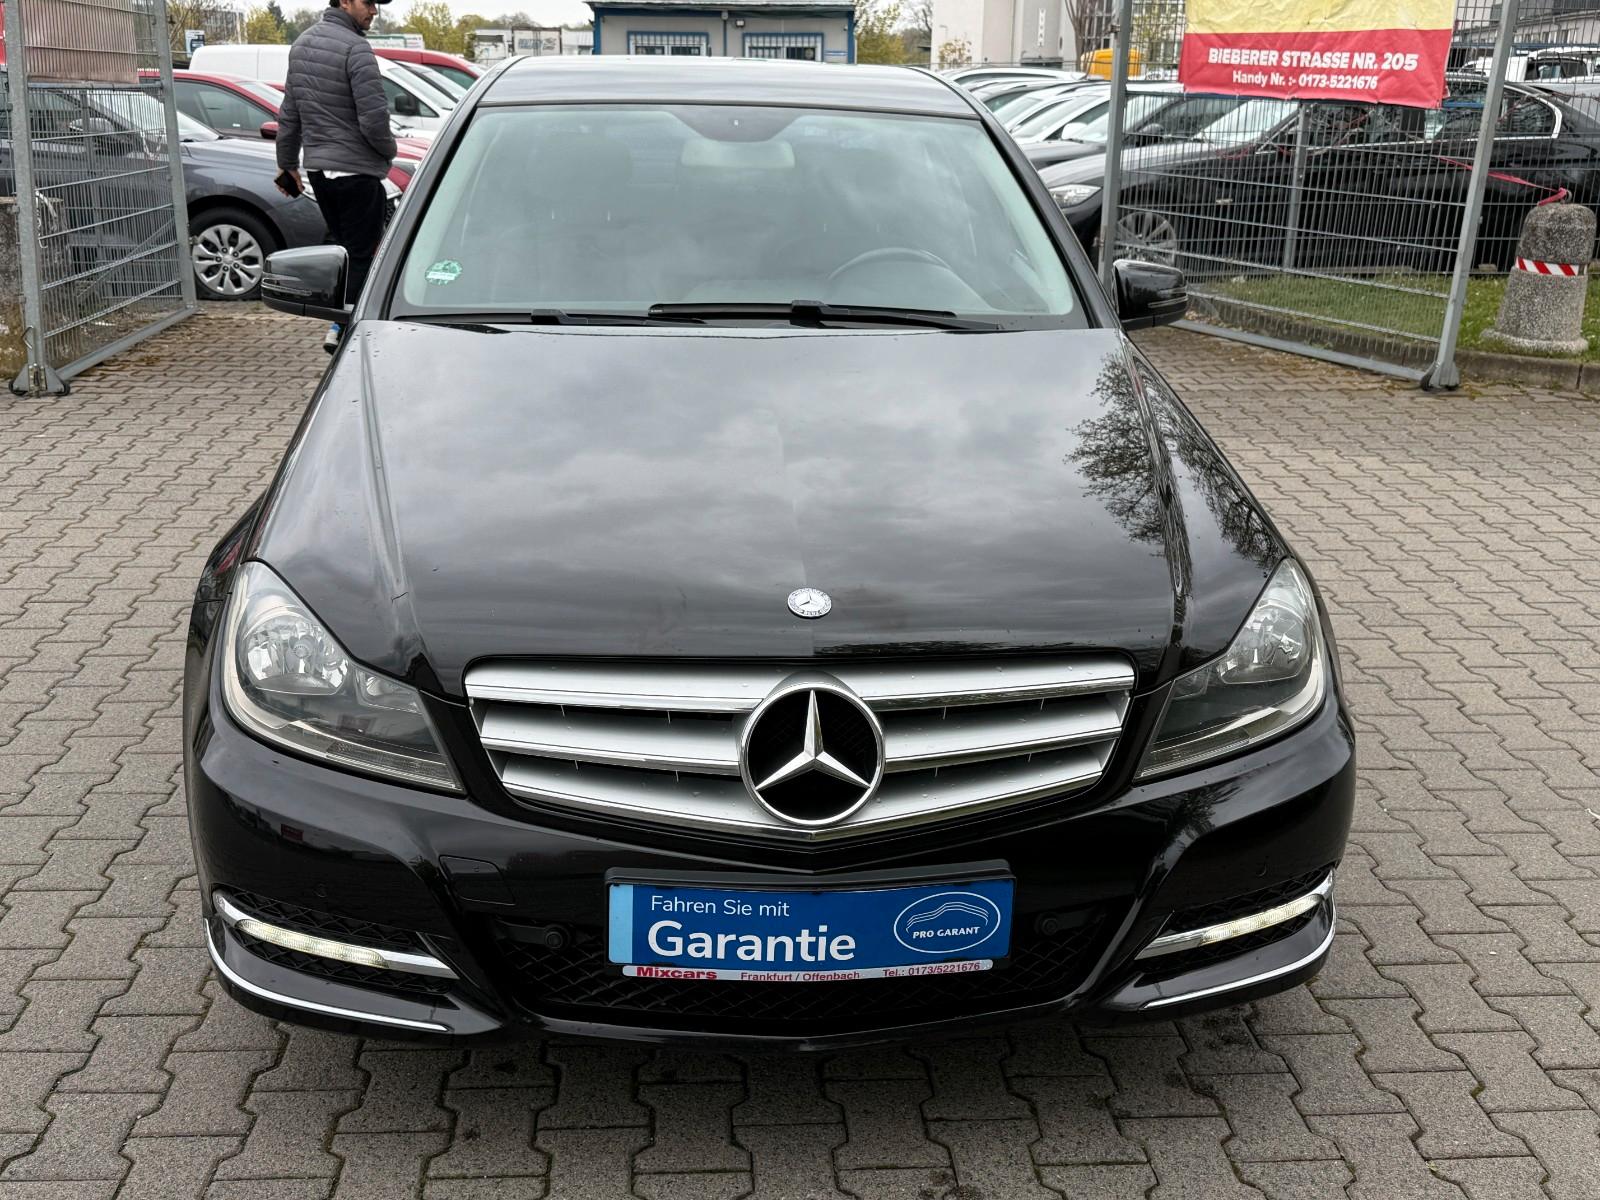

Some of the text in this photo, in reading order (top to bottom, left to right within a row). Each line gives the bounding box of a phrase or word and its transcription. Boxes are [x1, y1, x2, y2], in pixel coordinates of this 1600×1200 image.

[1208, 48, 1419, 71] BIEBERER STRASSE NR. 205
[1233, 71, 1268, 87] Handy
[1270, 73, 1286, 86] Nr.
[1299, 76, 1378, 89] 0173-5221676
[651, 895, 790, 917] Fahren Sie mit
[648, 920, 856, 962] Garantie
[912, 926, 980, 939] PRO GARANT
[636, 967, 717, 979] Mixcars
[740, 972, 792, 981] Frankfurt
[802, 971, 860, 982] Offenbach
[908, 962, 980, 976] 0173/5221676
